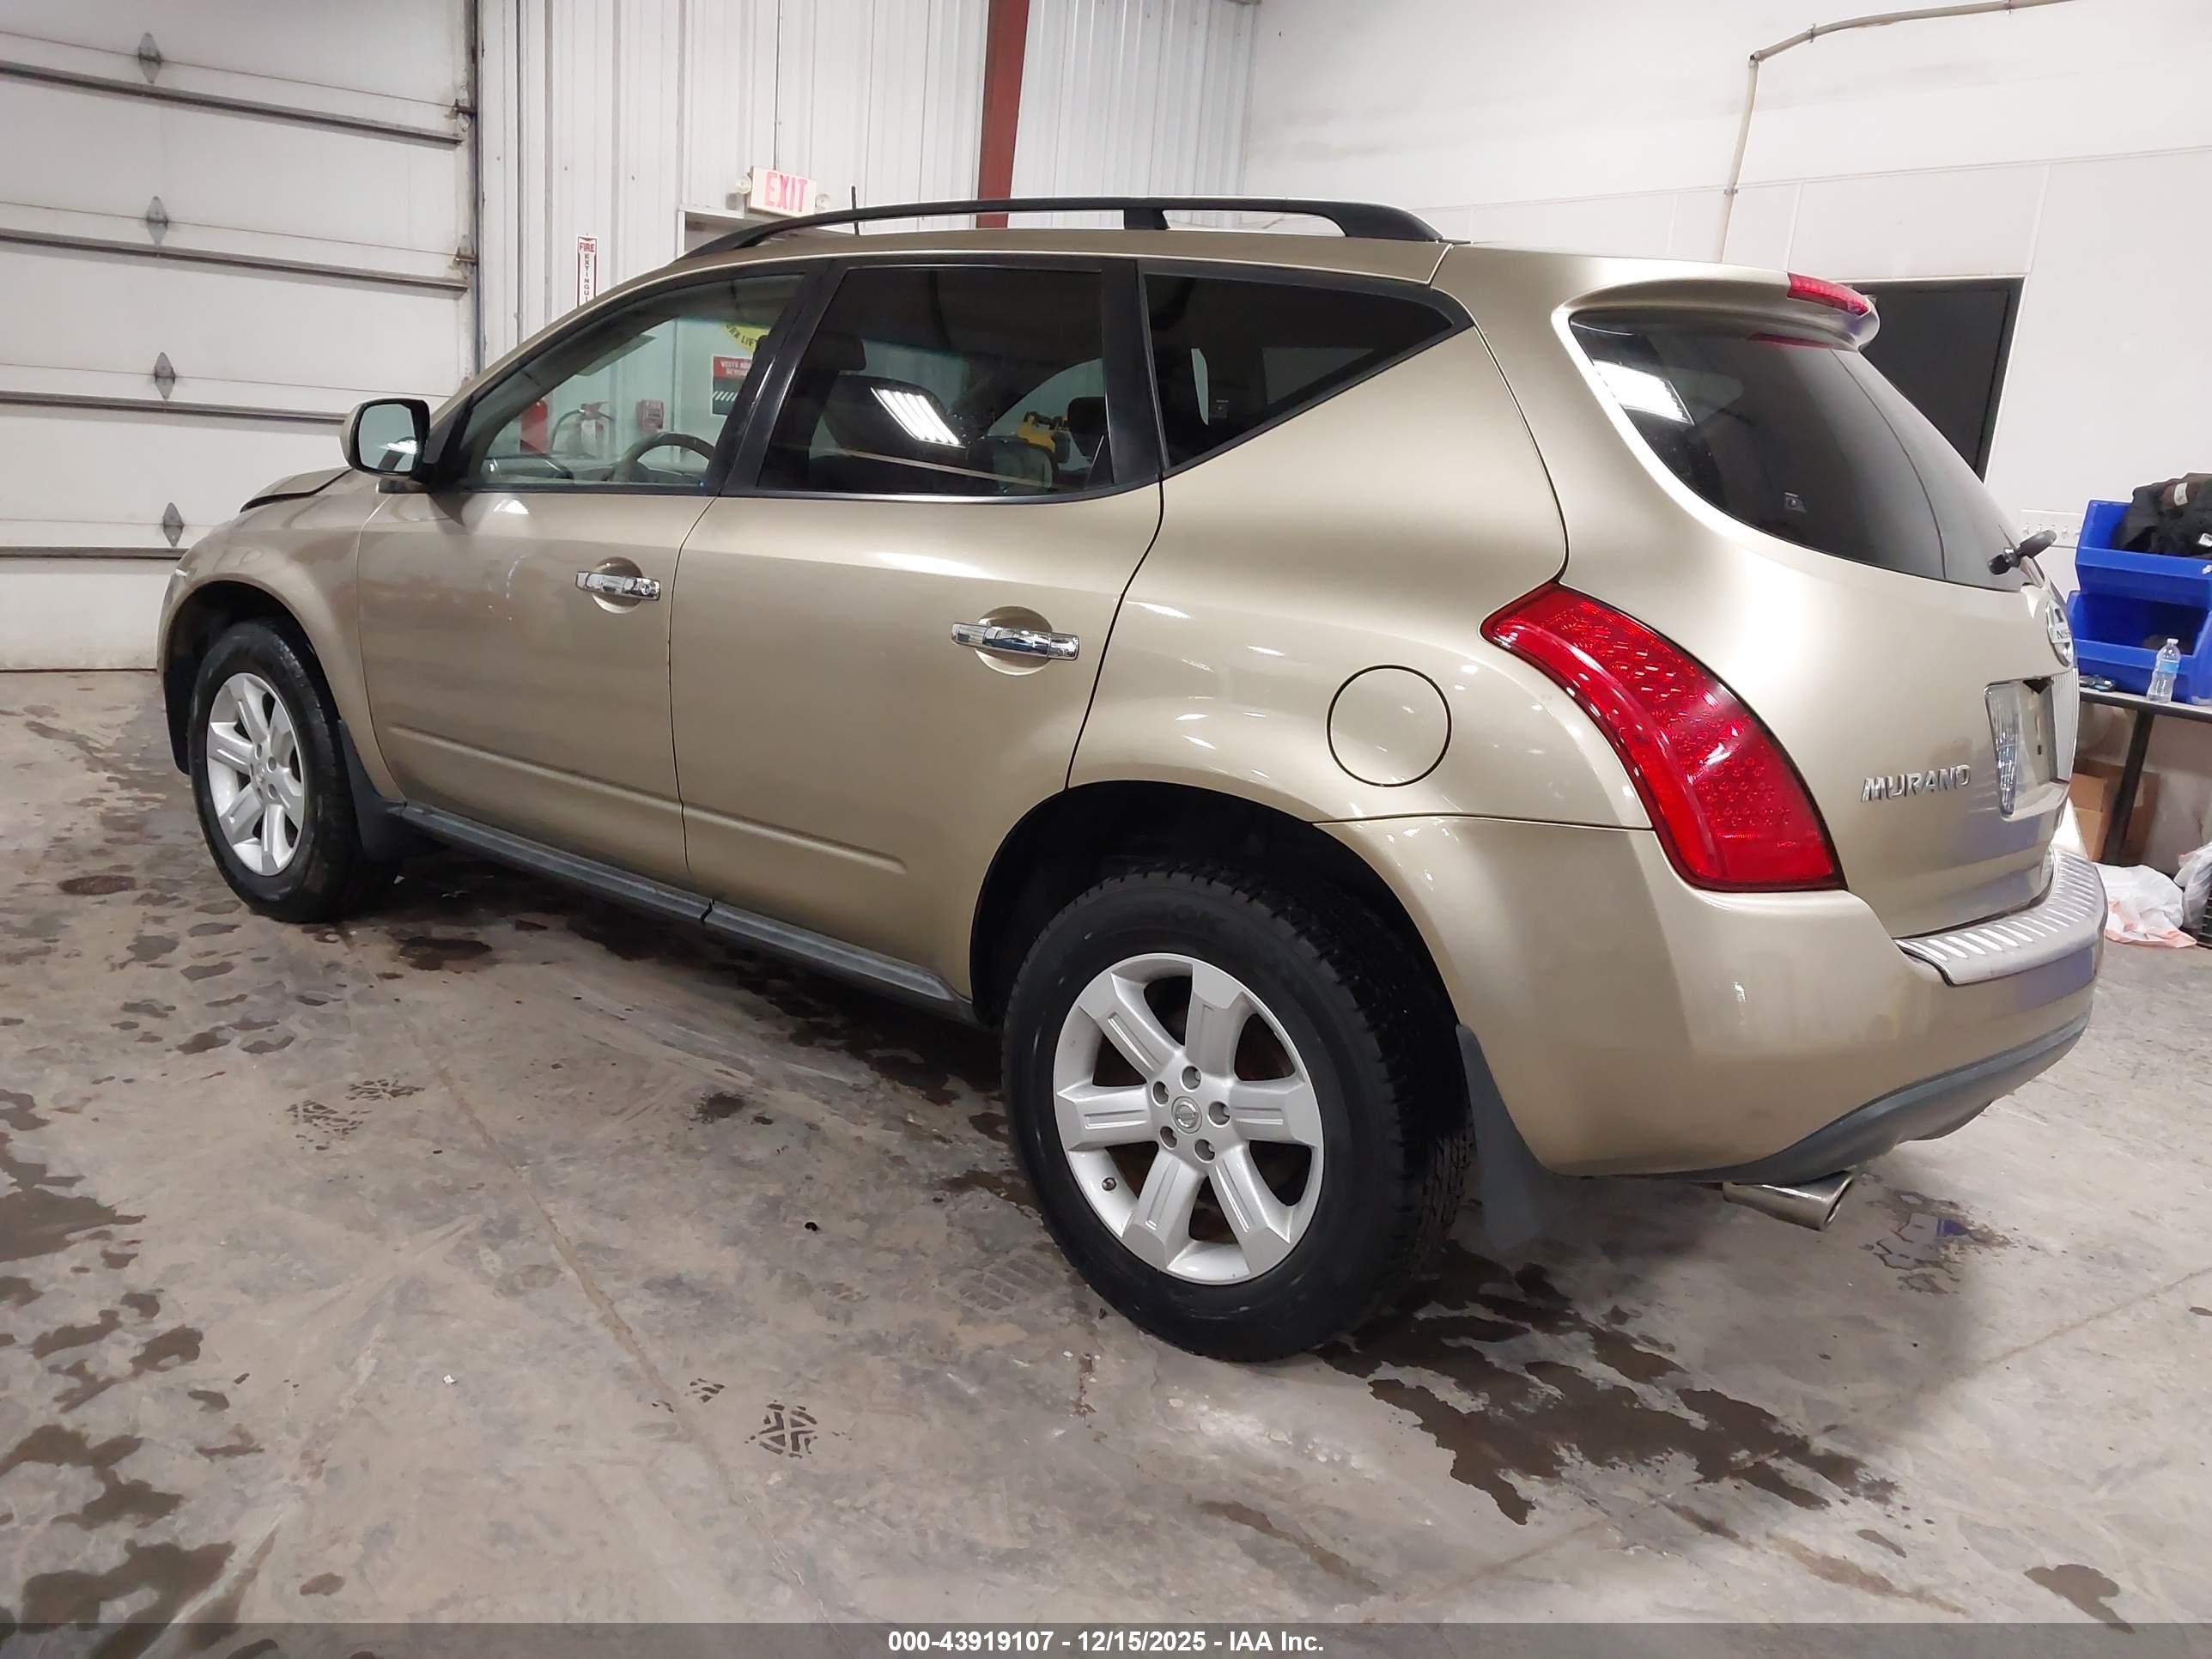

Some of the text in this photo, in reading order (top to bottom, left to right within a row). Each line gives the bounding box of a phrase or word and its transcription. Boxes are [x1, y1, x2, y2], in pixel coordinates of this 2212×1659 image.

[763, 172, 807, 212] EXIT
[579, 241, 595, 252] FIRE
[1861, 763, 1971, 802] MURANO
